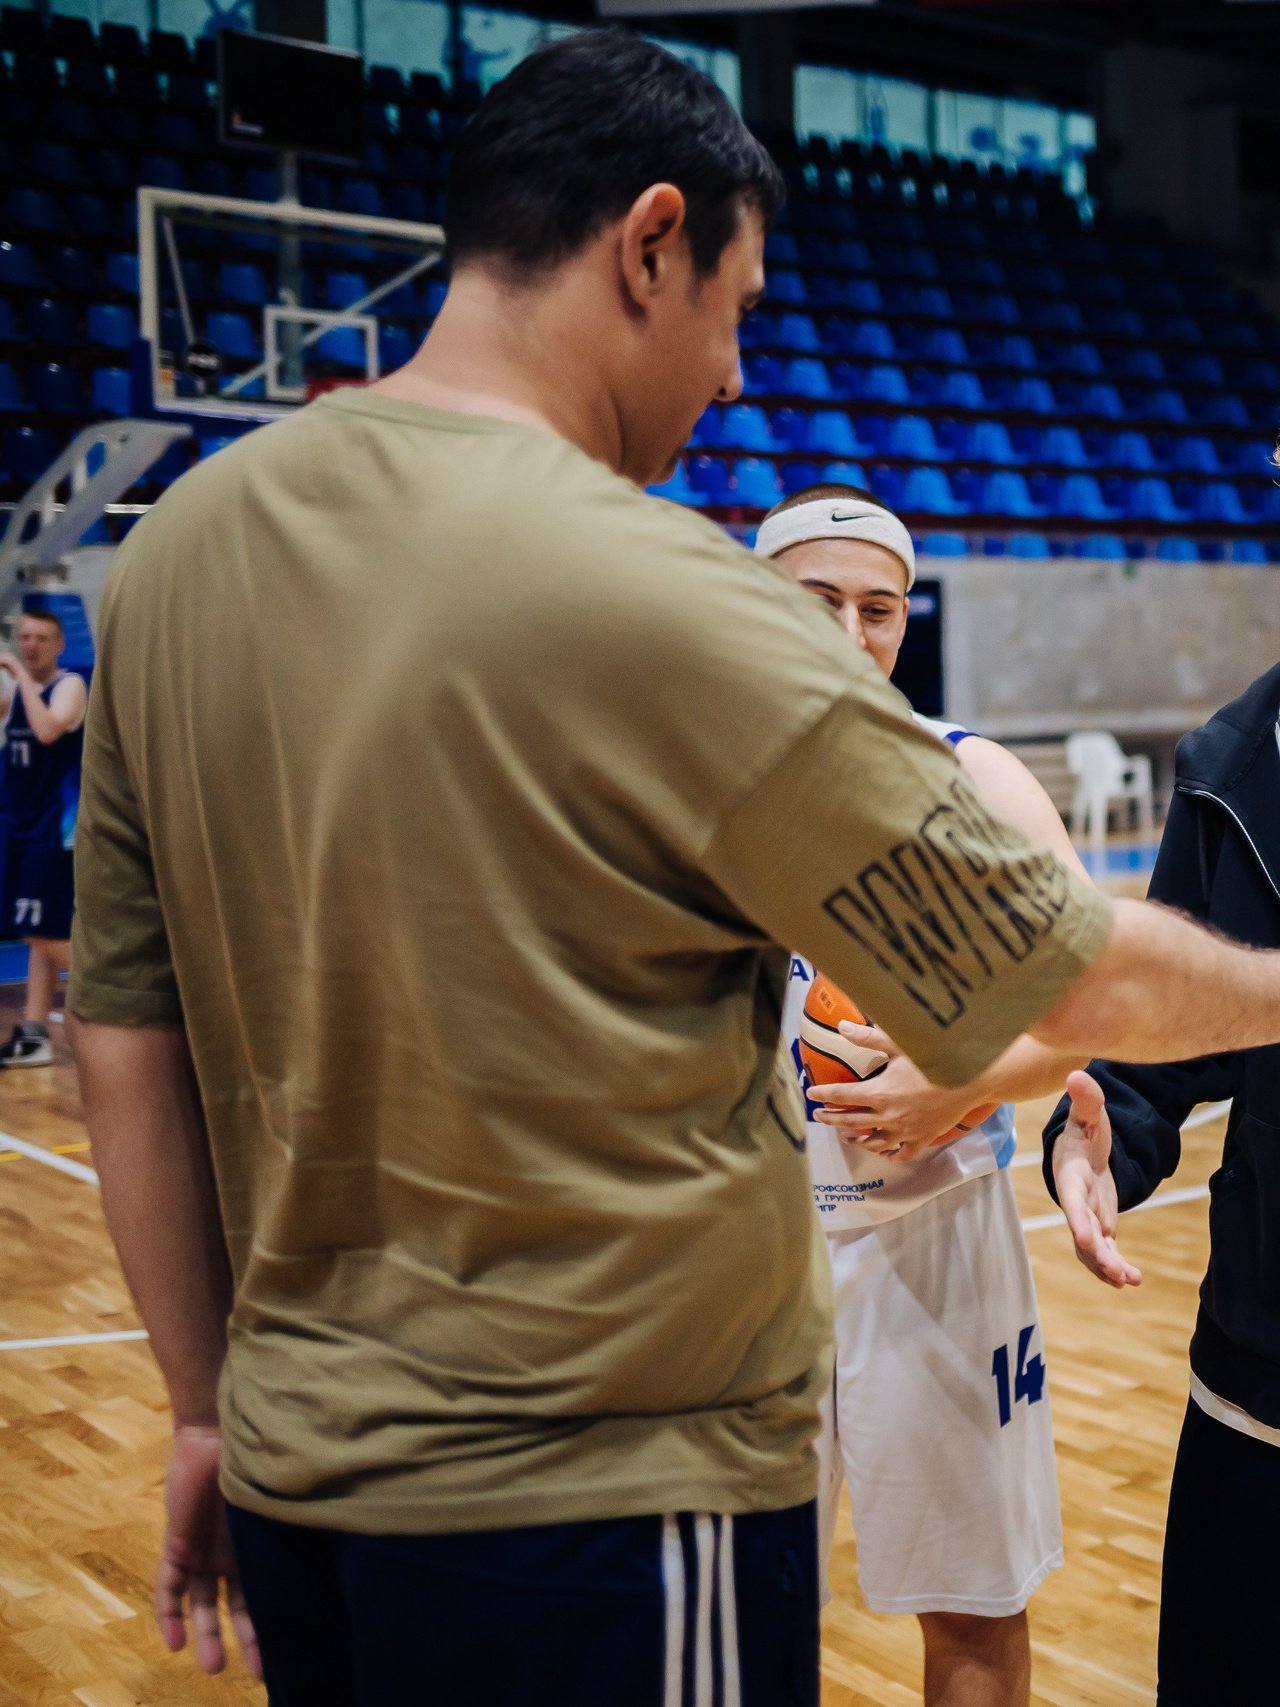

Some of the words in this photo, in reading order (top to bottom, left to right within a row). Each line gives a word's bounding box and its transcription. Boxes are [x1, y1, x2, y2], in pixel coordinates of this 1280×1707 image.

[15, 897, 42, 926] 71
[824, 1194, 866, 1202] ГРУППЫ
[991, 1324, 1046, 1428] 14
